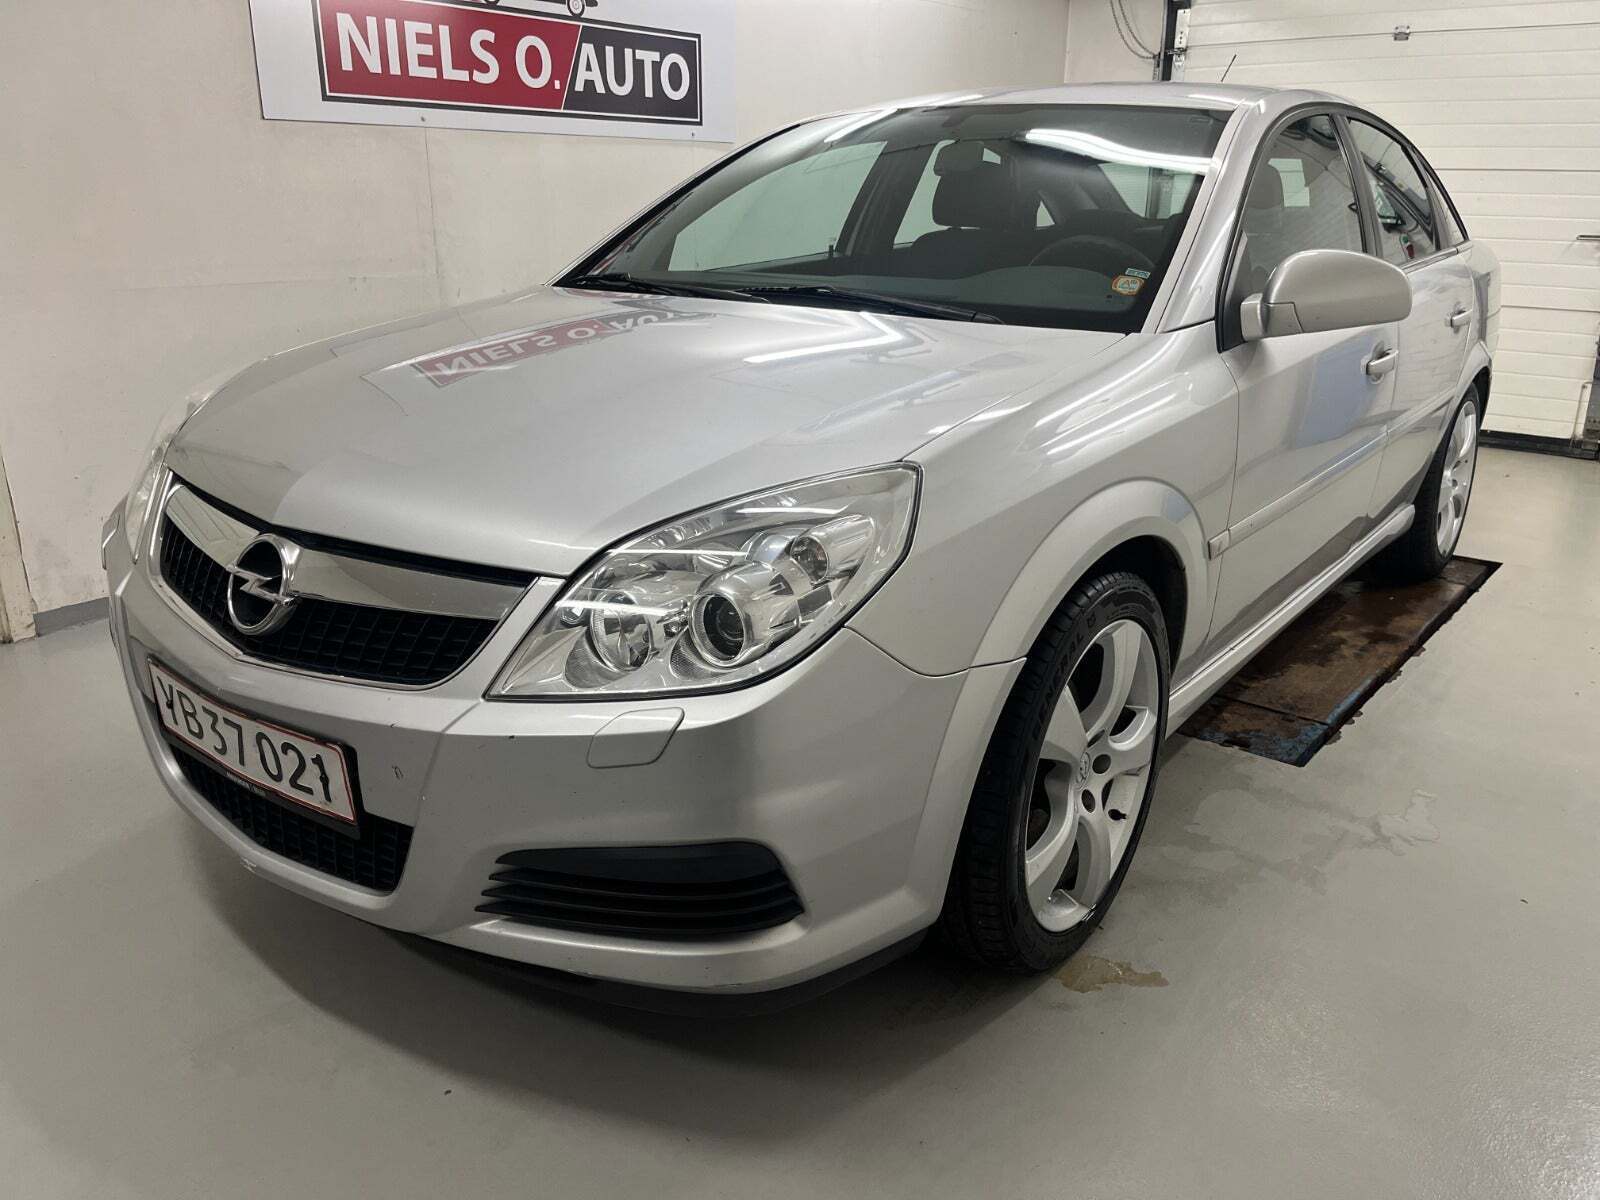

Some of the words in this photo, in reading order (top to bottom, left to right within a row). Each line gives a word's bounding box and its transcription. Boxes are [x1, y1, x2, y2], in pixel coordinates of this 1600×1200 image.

[336, 12, 500, 84] NIELS
[515, 35, 561, 90] O.
[574, 43, 690, 100] AUTO
